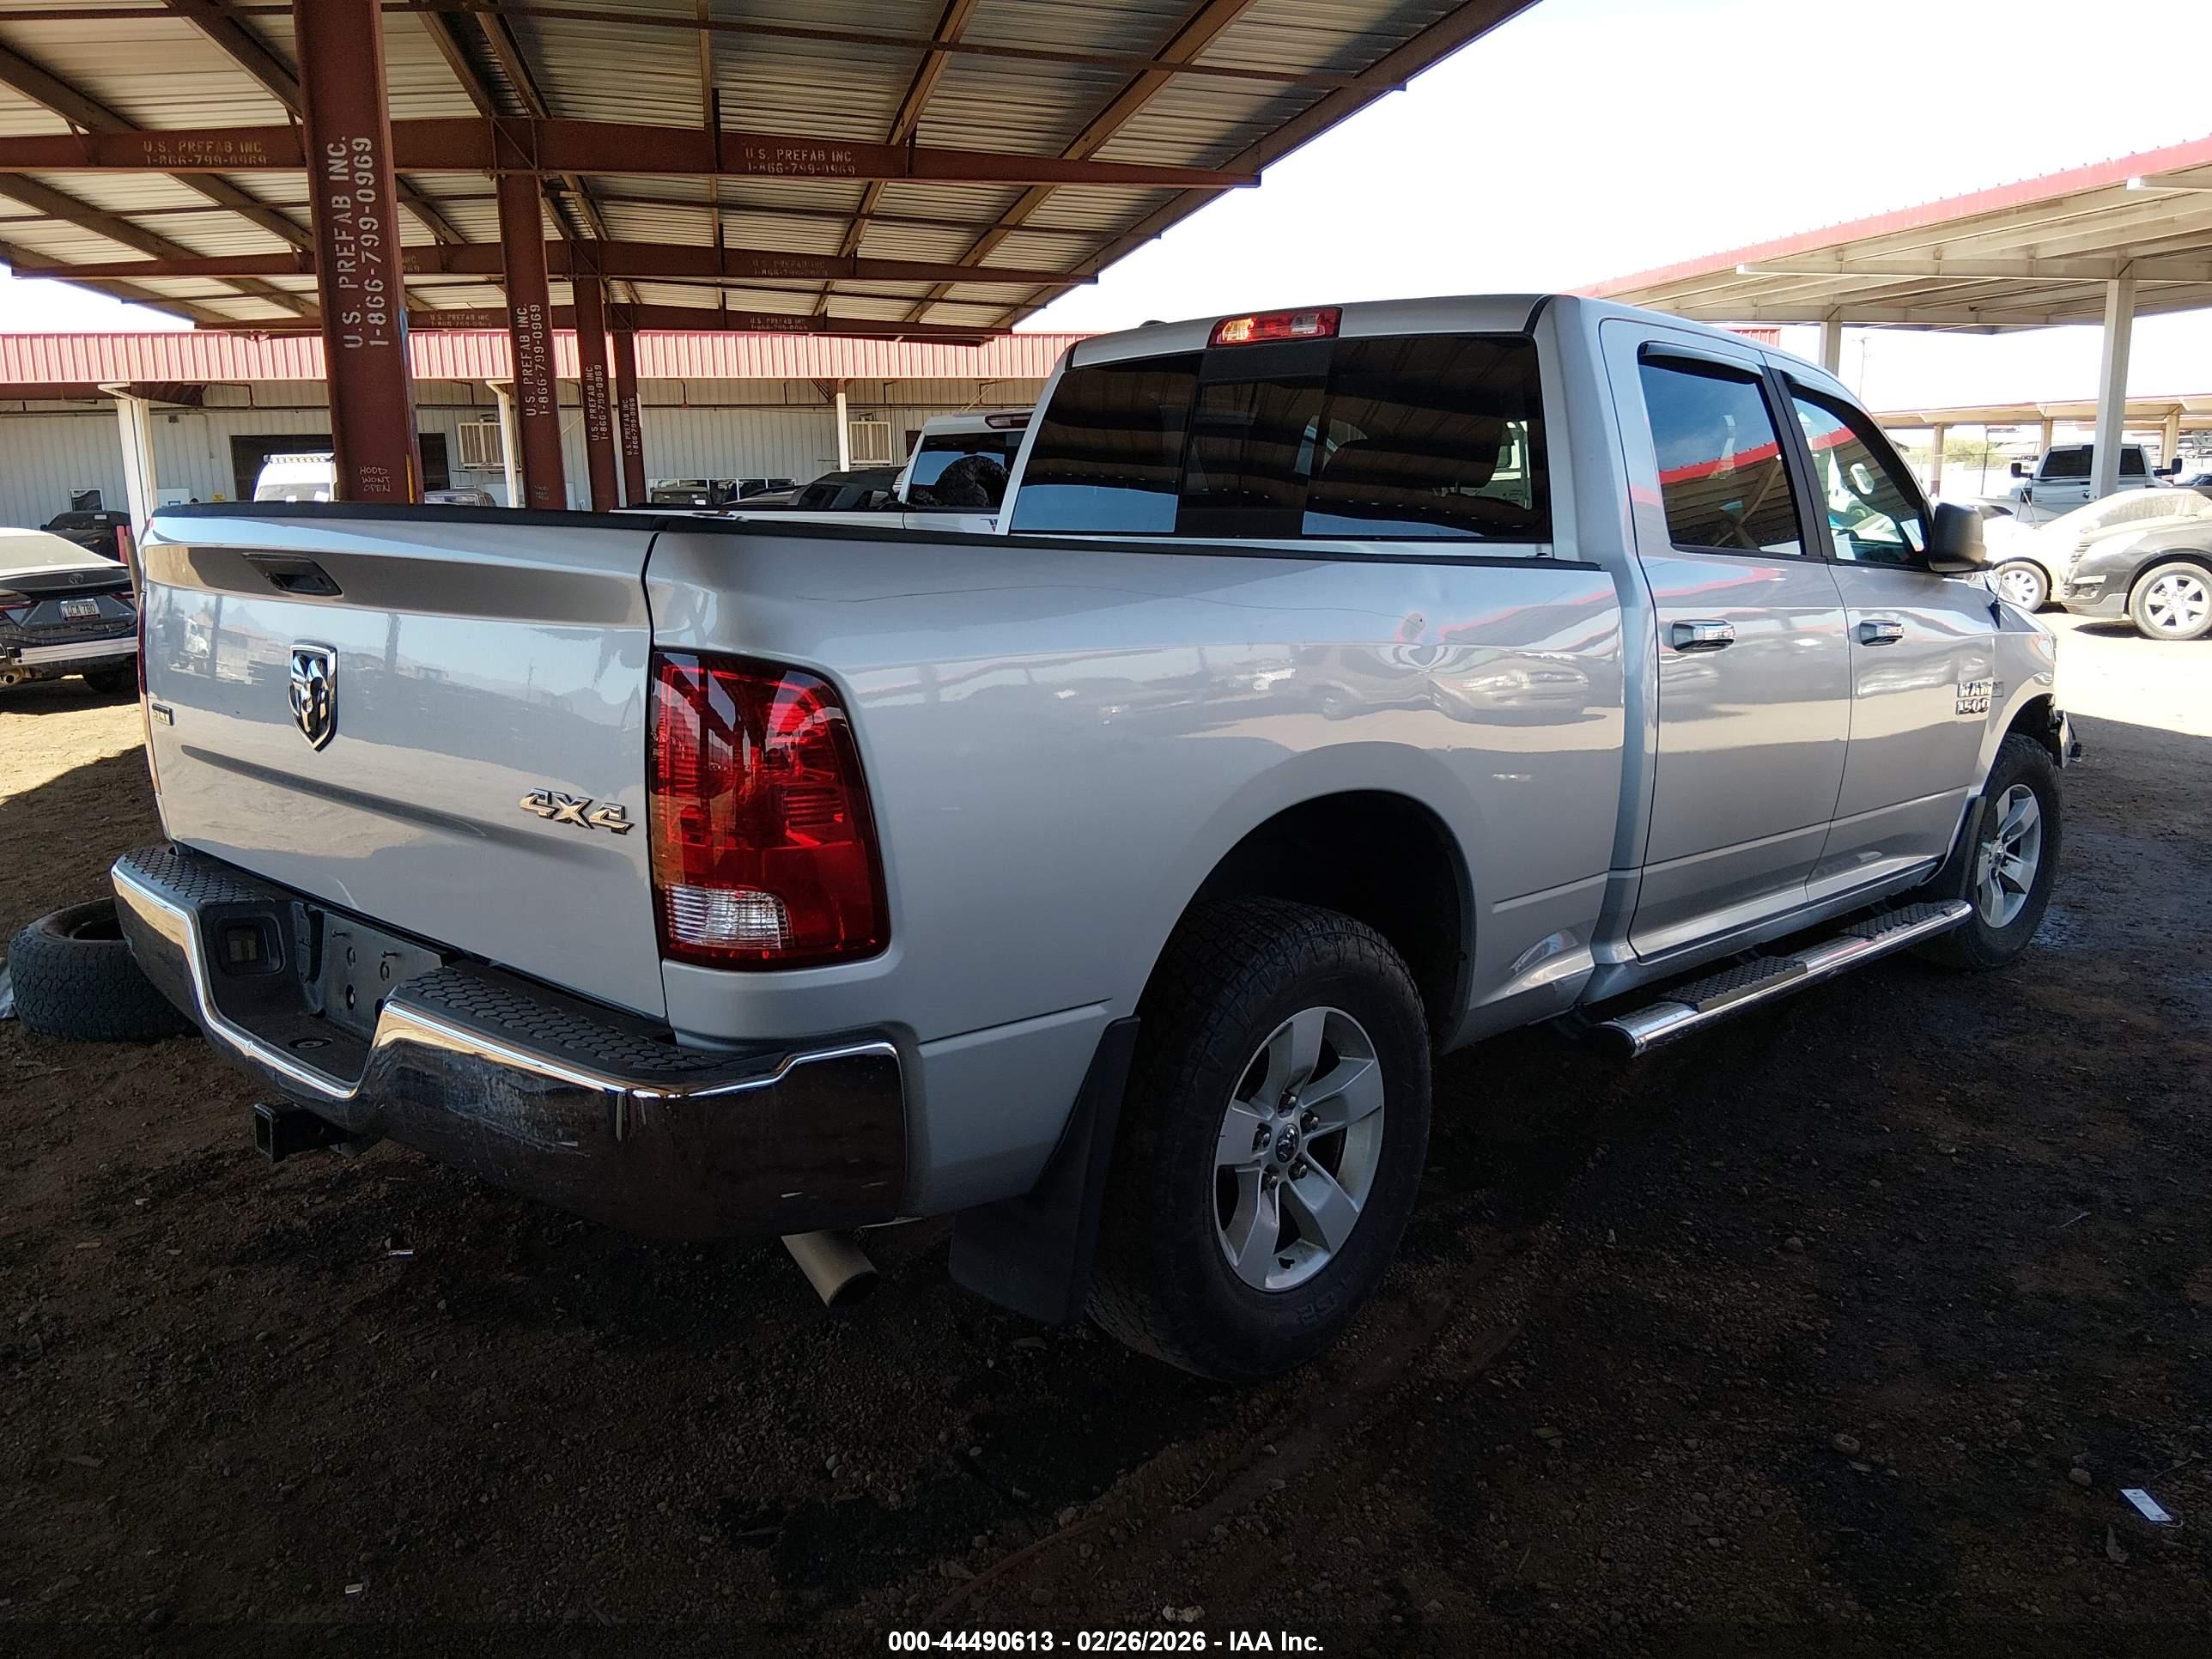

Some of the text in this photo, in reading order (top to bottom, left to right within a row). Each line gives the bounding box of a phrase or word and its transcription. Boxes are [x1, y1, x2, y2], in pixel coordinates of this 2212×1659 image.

[776, 149, 825, 161] PREFAB
[327, 137, 363, 349] U.S. PREFAB INC.
[352, 137, 389, 346] 1-866-799-0969
[519, 334, 533, 385] PREFAB
[529, 304, 550, 415] 1-866-799-0969
[525, 392, 537, 416] U.S.
[586, 385, 598, 419] PREFAB
[1957, 681, 1992, 697] RAM
[1955, 698, 1990, 715] 1500
